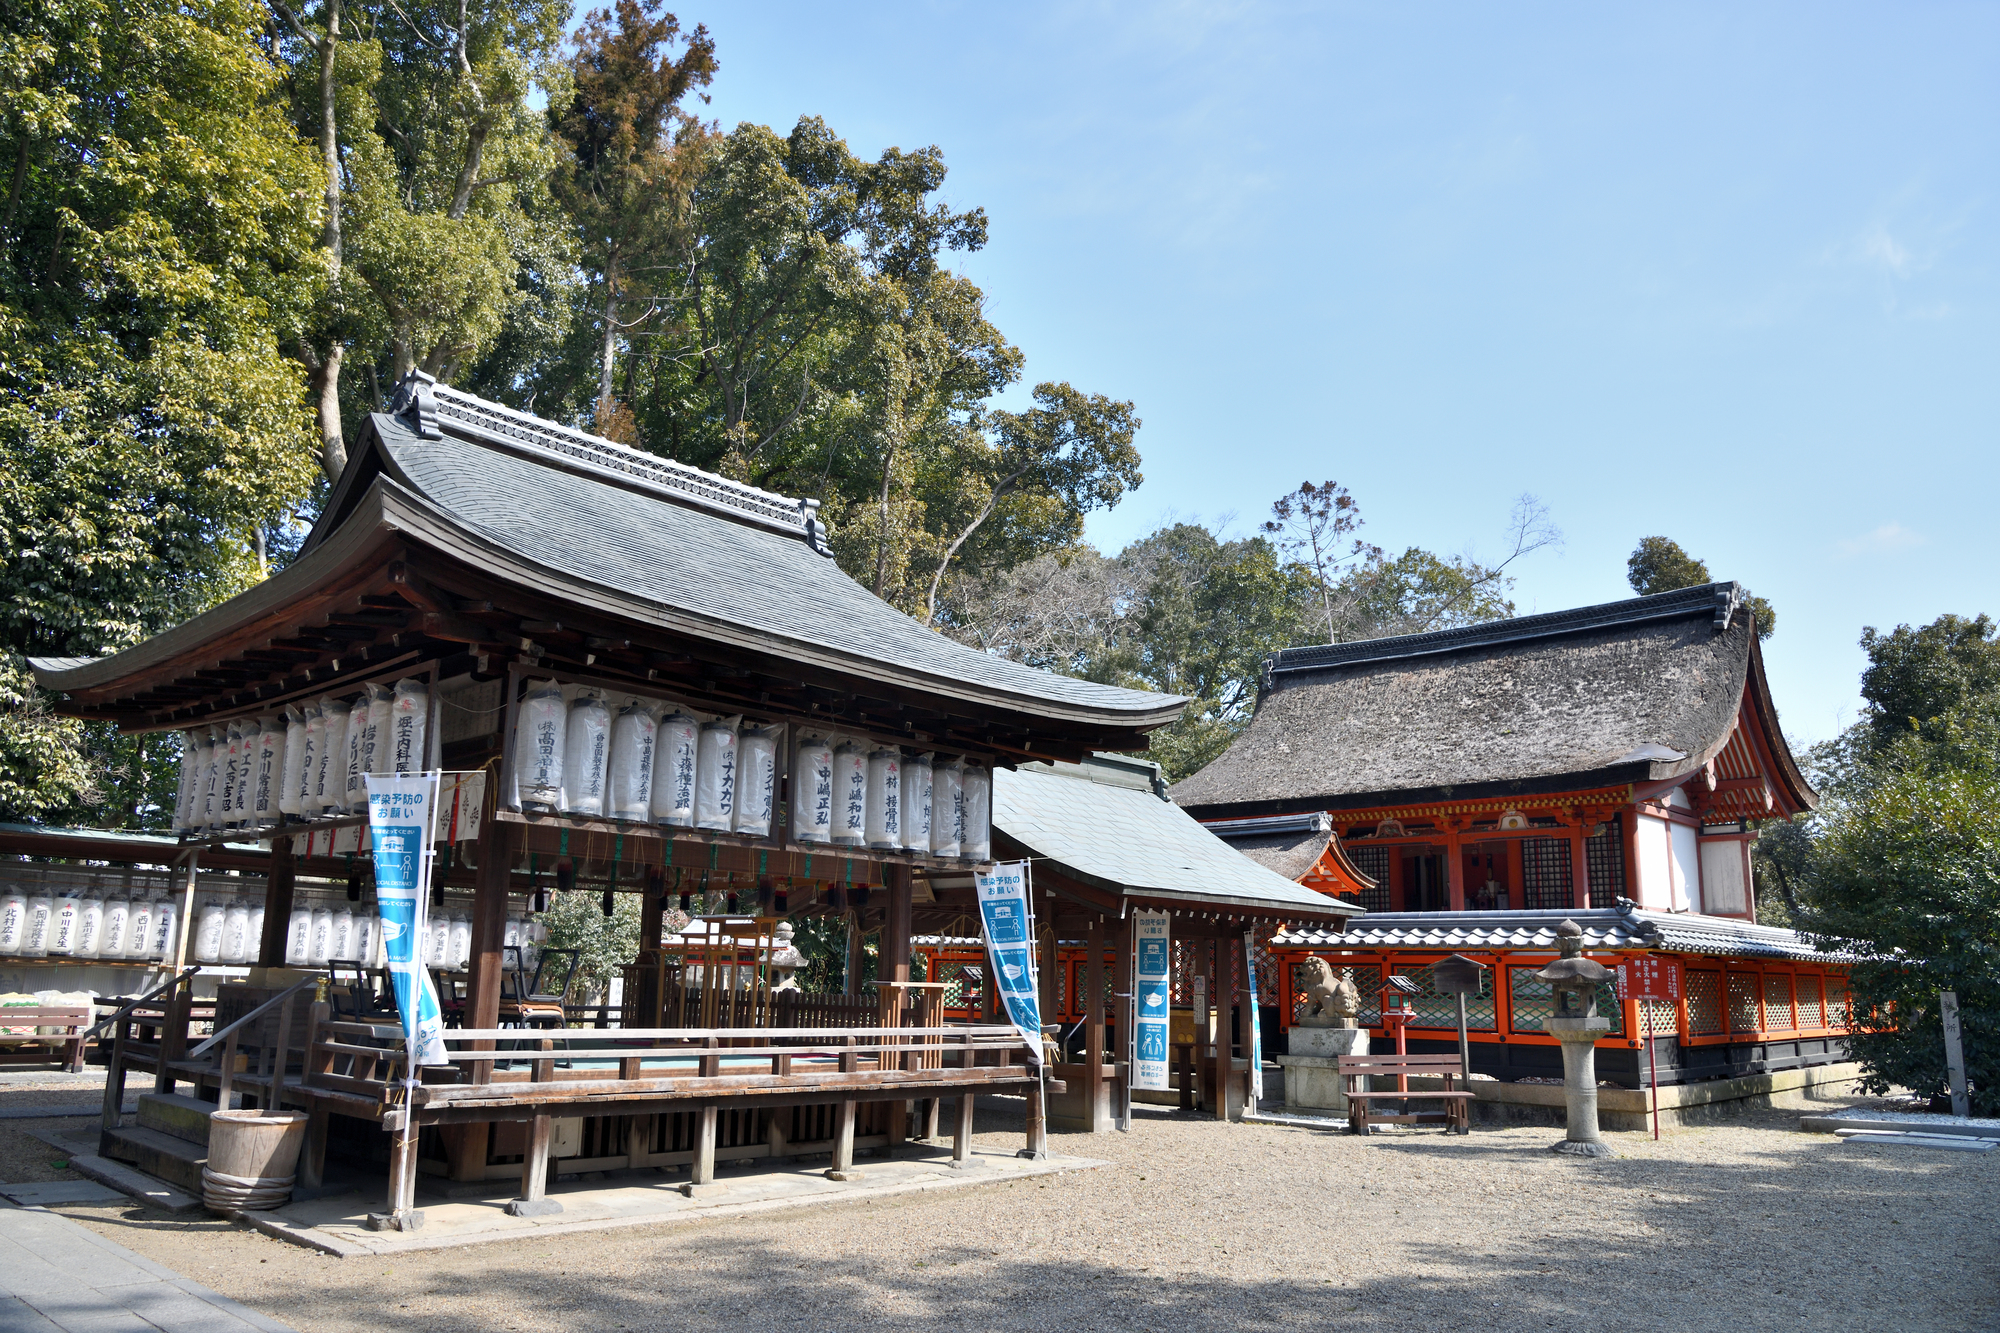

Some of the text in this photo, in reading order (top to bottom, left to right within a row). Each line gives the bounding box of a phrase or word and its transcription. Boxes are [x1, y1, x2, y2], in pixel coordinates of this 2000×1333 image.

[402, 699, 412, 712] 奉
[887, 762, 898, 774] 奉
[370, 793, 423, 805] 感染予防の
[815, 766, 832, 826] 中嶋正弘
[846, 771, 864, 830] 中嶋和弘
[377, 807, 414, 819] お願い
[980, 876, 1020, 886] 感染予防の
[987, 886, 1015, 896] お願い
[1, 908, 18, 944] 北村広幸
[1643, 960, 1651, 993] たき火禁止
